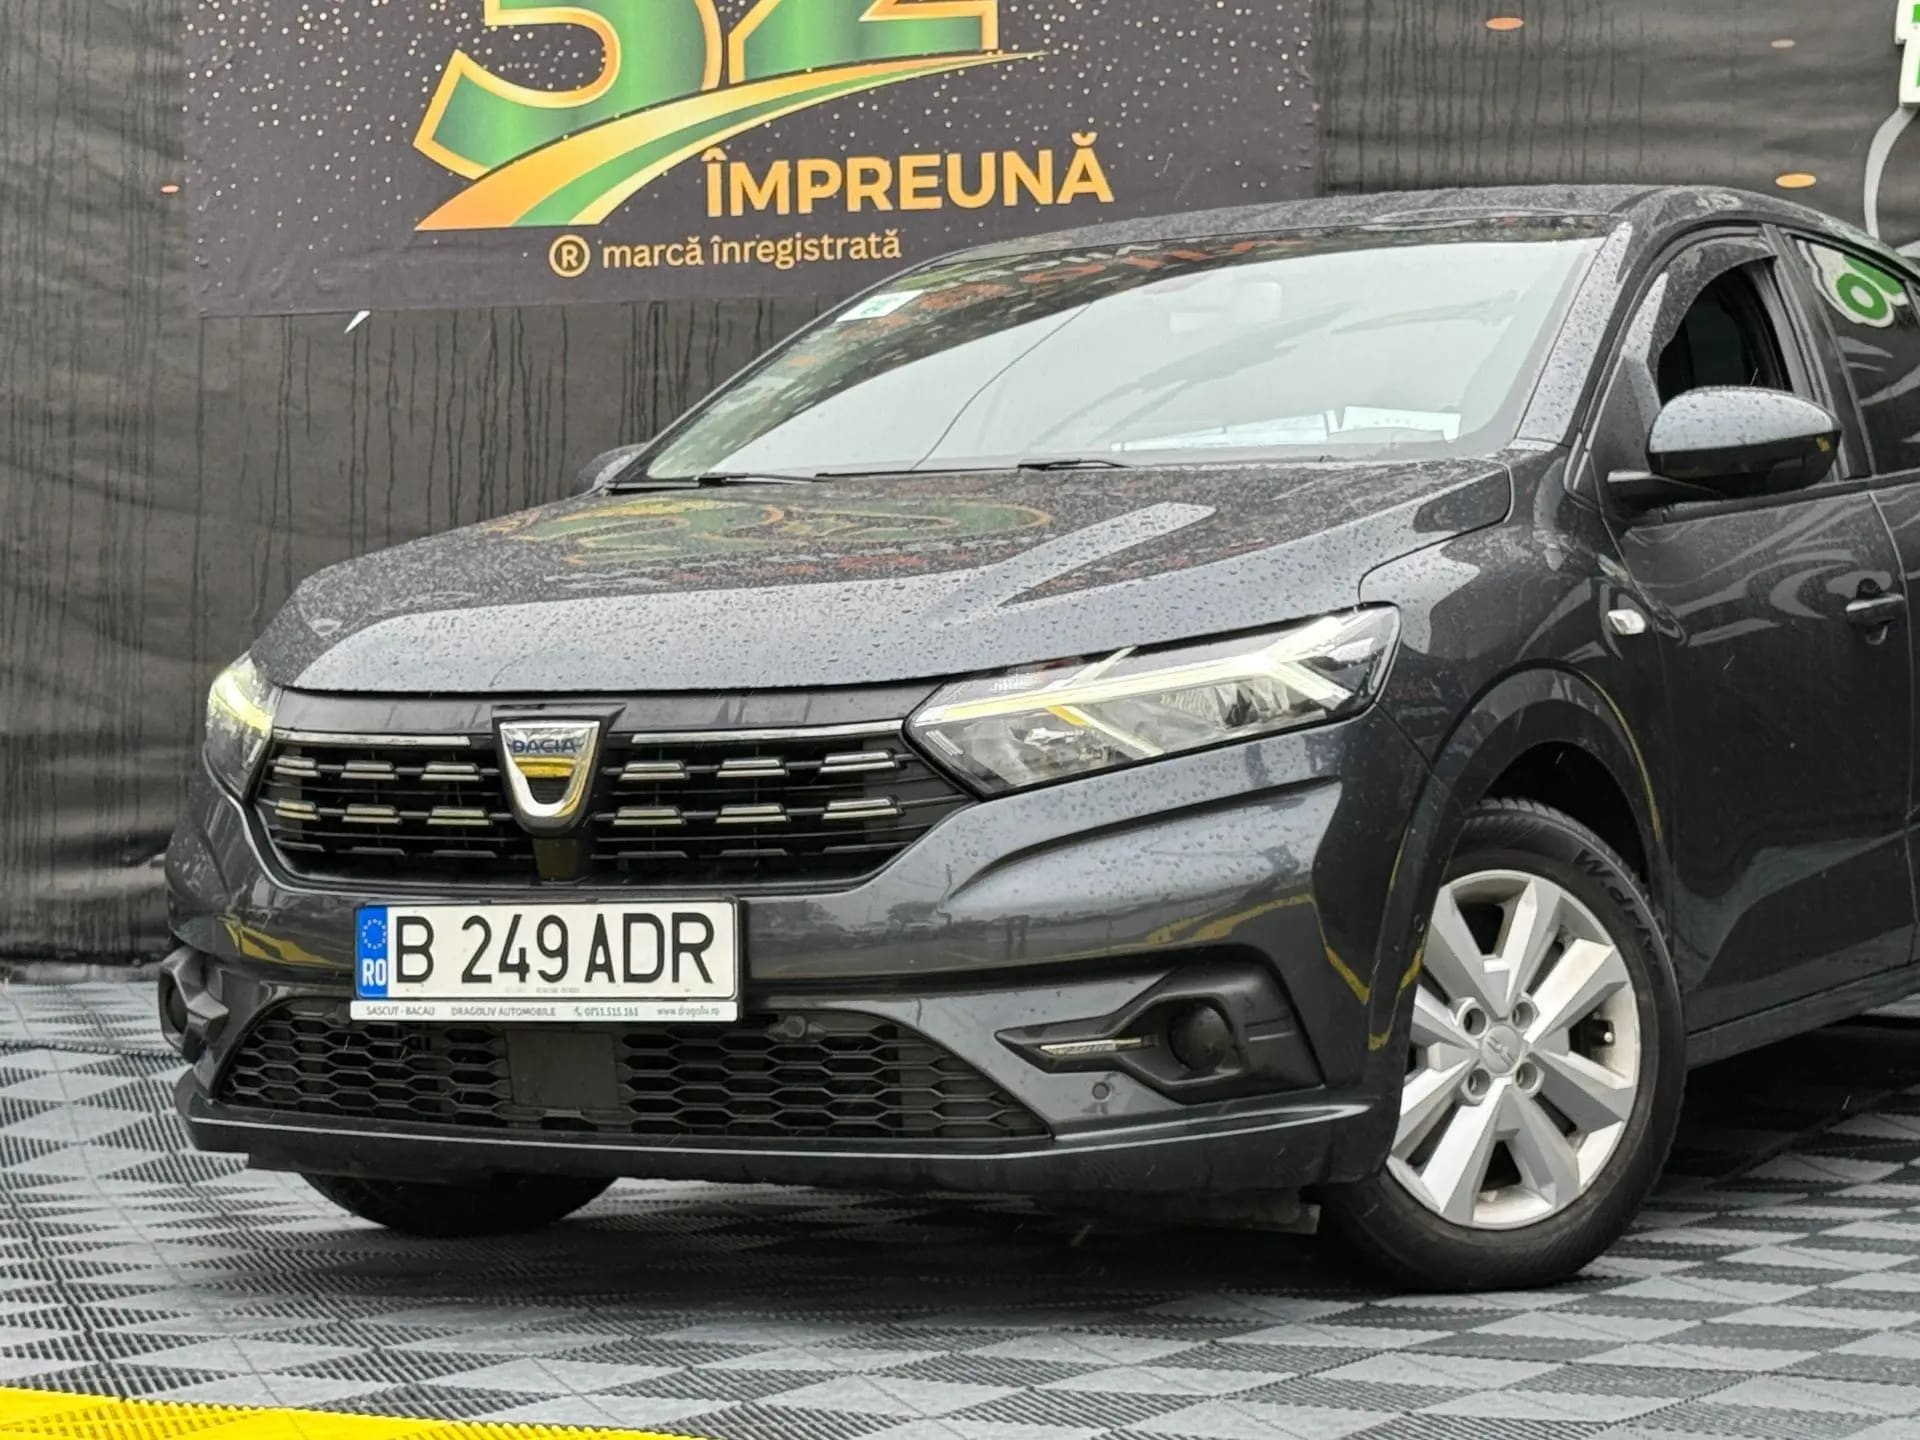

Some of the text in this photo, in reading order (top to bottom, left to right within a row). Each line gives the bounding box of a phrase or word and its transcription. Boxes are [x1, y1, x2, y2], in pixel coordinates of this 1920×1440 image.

[701, 132, 1116, 218] ÎMPREUNĂ
[602, 240, 705, 269] marcă
[710, 228, 903, 270] înregistrată
[512, 739, 578, 754] DACIA
[396, 912, 715, 984] B 249 ADR
[362, 958, 387, 987] RO
[451, 1006, 497, 1017] DRAGOLIV
[498, 1007, 557, 1018] AUTOMOBILE
